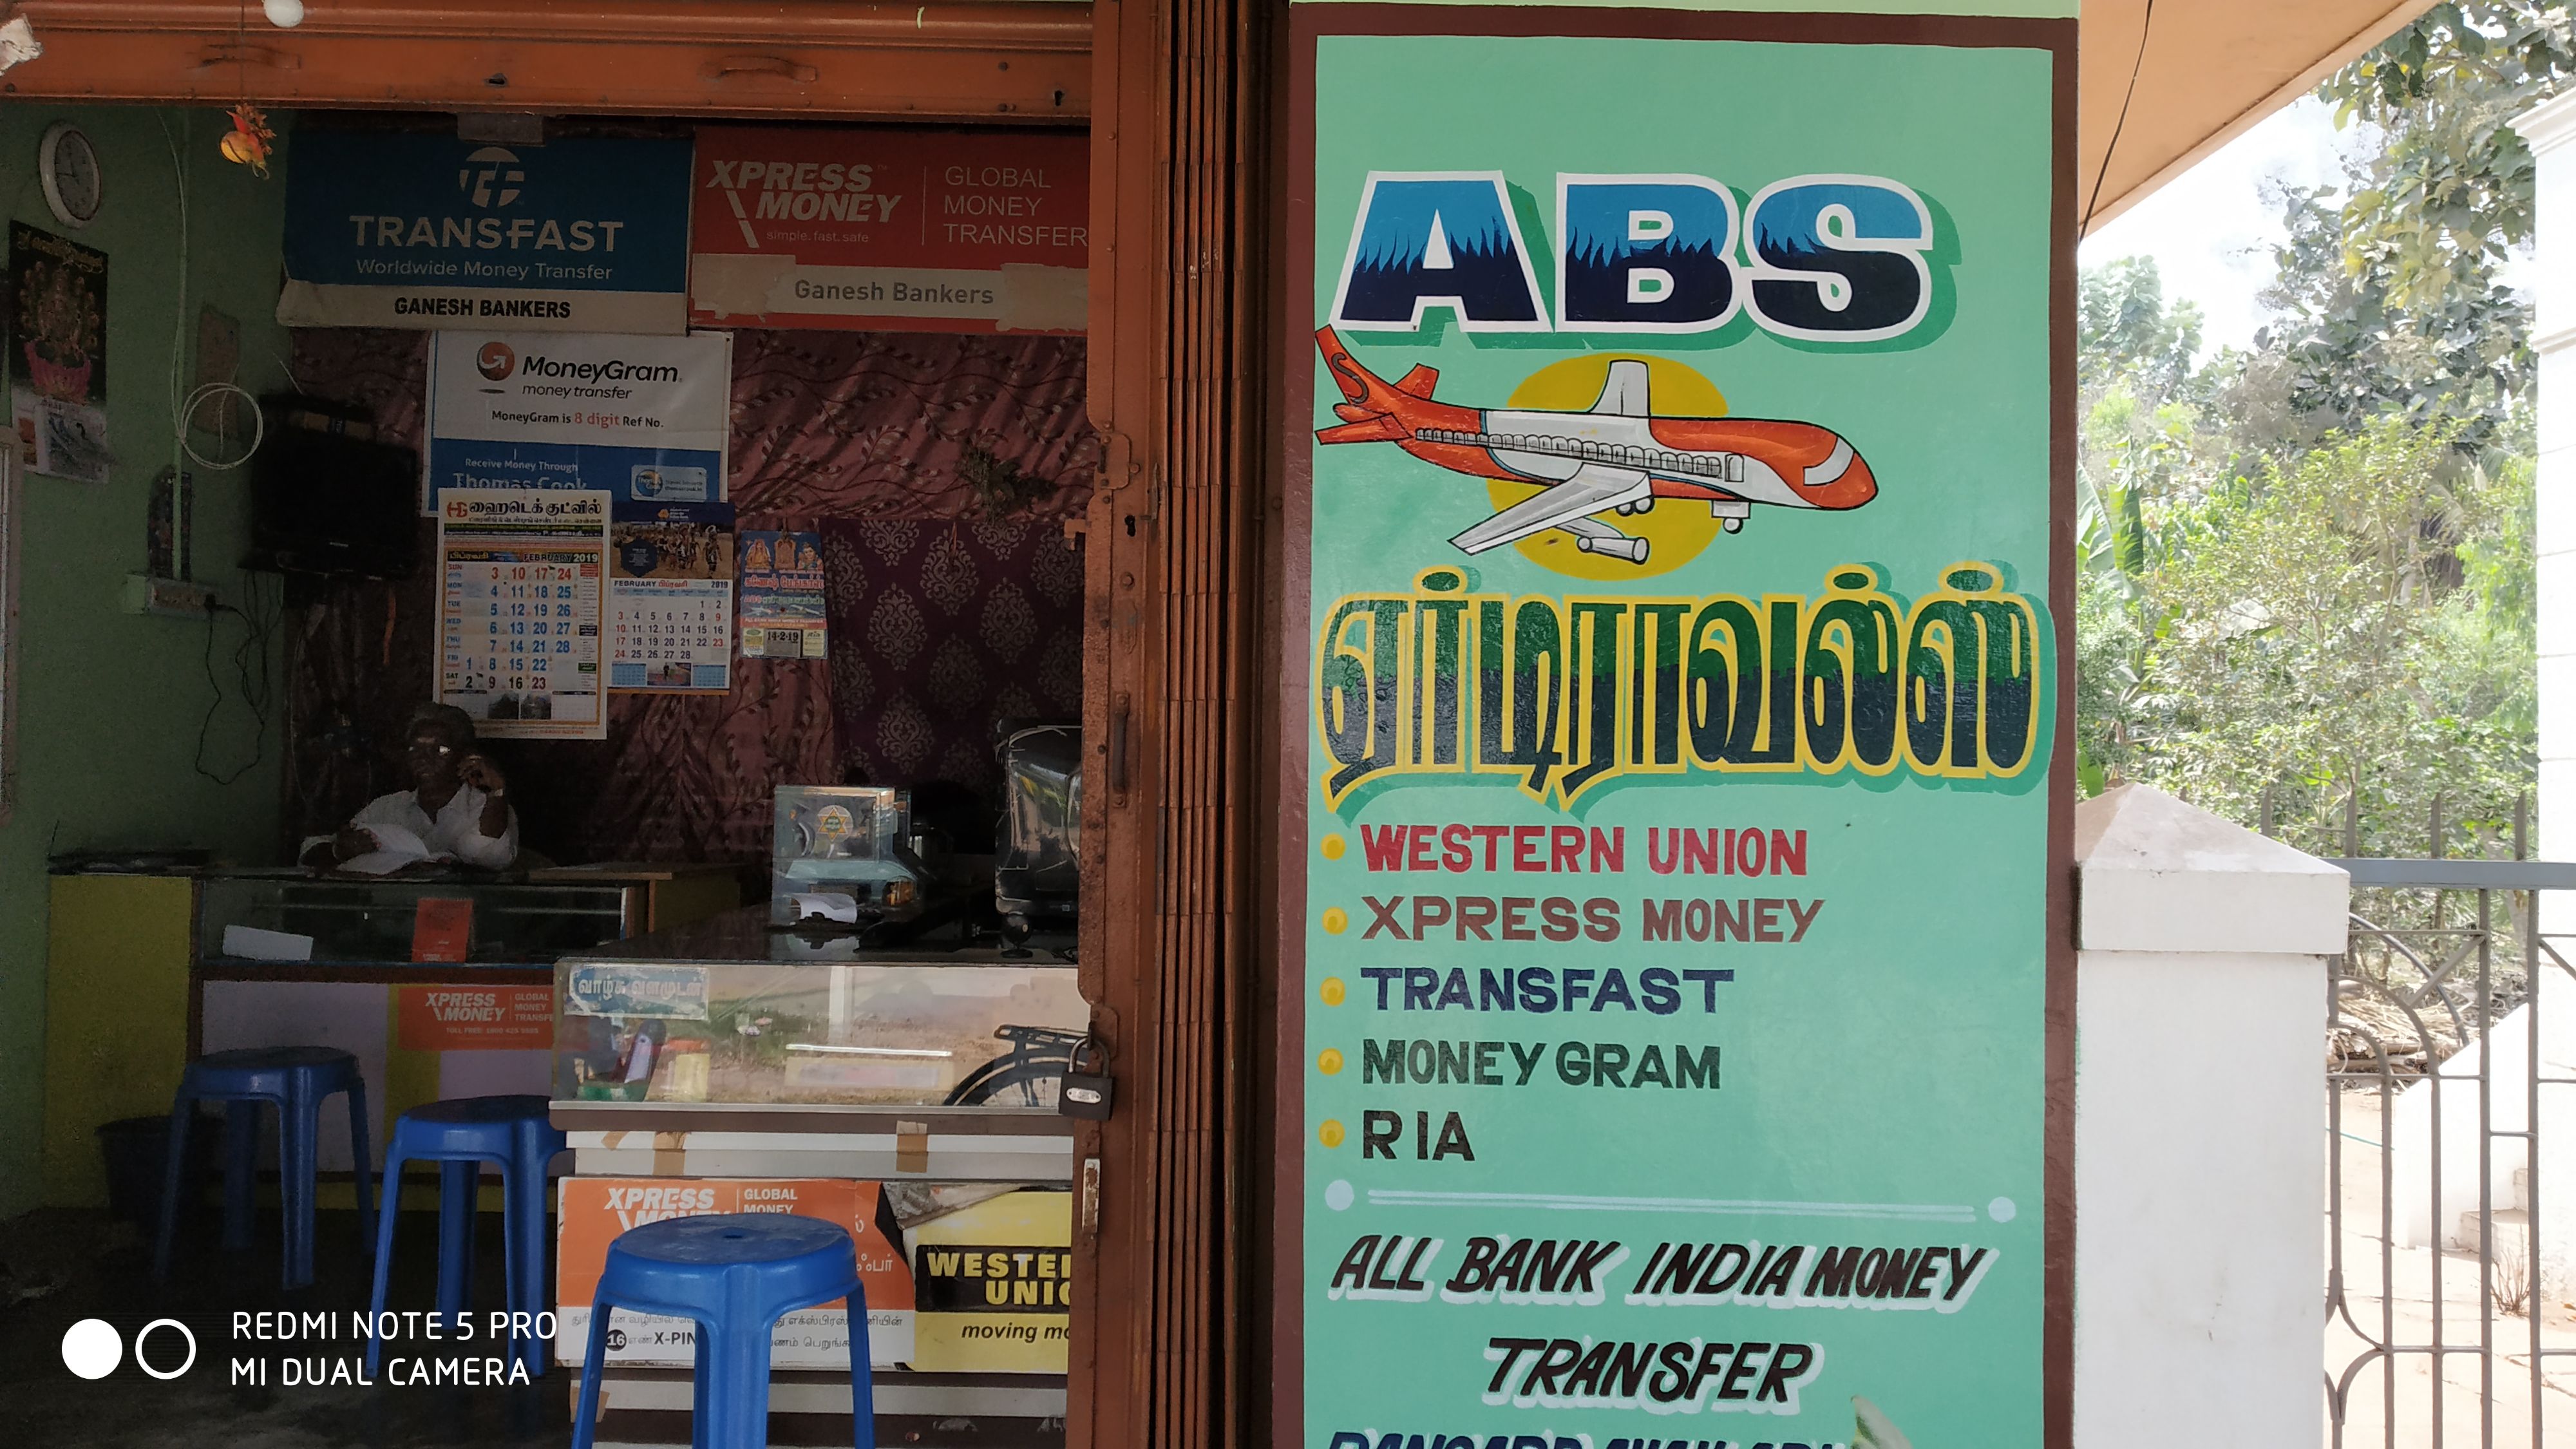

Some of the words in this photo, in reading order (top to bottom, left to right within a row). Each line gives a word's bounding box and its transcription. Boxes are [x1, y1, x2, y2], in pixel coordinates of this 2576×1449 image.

[706, 160, 873, 193] XPRESS
[945, 166, 1051, 189] GLOBAL
[755, 192, 902, 223] MONEY
[943, 195, 1041, 216] MONEY
[349, 214, 624, 252] TRANSFAST
[842, 232, 869, 242] safe
[943, 223, 1088, 247] TRANSFER
[1329, 170, 1934, 343] ABS
[356, 259, 457, 276] Worldwide
[464, 261, 528, 281] Money
[535, 261, 612, 279] Transfer
[795, 279, 884, 301] Ganesh
[893, 282, 994, 304] Bankers
[394, 297, 473, 316] GANESH
[480, 299, 571, 319] BANKERS
[522, 356, 677, 384] MoneyGram
[522, 385, 571, 399] money
[574, 386, 632, 399] transfer
[491, 410, 559, 424] MoneyGram
[562, 413, 571, 423] is
[574, 412, 583, 424] 8
[587, 412, 619, 428] digit
[623, 416, 642, 426] Ref
[645, 418, 664, 428] No.
[466, 458, 502, 468] Receive
[504, 460, 536, 471] Money
[538, 461, 578, 473] Through
[524, 553, 573, 562] FEBRUARY
[573, 554, 598, 562] 2019
[491, 567, 498, 580] 3
[511, 567, 526, 580] 10
[535, 567, 547, 580] 17
[558, 568, 571, 580] 24
[491, 585, 498, 597] 4
[511, 585, 524, 597] 11
[535, 586, 547, 598] 18
[557, 586, 571, 598] 25
[490, 603, 497, 616] 5
[511, 603, 525, 616] 12
[534, 604, 547, 616] 19
[556, 604, 571, 617] 26
[716, 600, 721, 609] 2
[667, 612, 672, 621] 6
[683, 612, 688, 621] 7
[489, 622, 497, 634] 6
[510, 622, 524, 634] 13
[533, 622, 547, 634] 20
[556, 622, 571, 634] 27
[649, 625, 658, 633] 12
[490, 639, 497, 652] 7
[510, 640, 524, 652] 14
[533, 641, 545, 652] 21
[556, 641, 570, 653] 28
[664, 638, 674, 647] 20
[681, 638, 690, 647] 21
[696, 638, 707, 647] 22
[713, 638, 723, 647] 23
[631, 650, 641, 658] 25
[664, 650, 674, 659] 27
[680, 650, 690, 659] 28
[467, 658, 471, 670] 1
[489, 658, 496, 670] 8
[509, 658, 524, 670] 15
[532, 659, 547, 670] 22
[466, 676, 473, 688] 2
[489, 677, 495, 688] 9
[509, 677, 522, 689] 16
[532, 677, 546, 689] 23
[1360, 824, 1625, 873] WESTERN
[1648, 828, 1807, 876] UNION
[1360, 896, 1621, 943] XPRESS
[1643, 899, 1826, 943] MONEY
[1360, 967, 1734, 1015] TRANSFAST
[425, 992, 496, 1007] XPRESS
[444, 1008, 506, 1021] MONEY
[1362, 1110, 1475, 1161] RIA
[603, 1188, 714, 1210] XPRESS
[744, 1189, 797, 1200] GLOBAL
[744, 1204, 793, 1214] MONEY
[1331, 1235, 1432, 1290] ALL
[1448, 1238, 1620, 1294] BANK
[1633, 1242, 1804, 1296] INDIA
[1805, 1245, 1987, 1302] MONEY
[607, 1334, 626, 1346] 16
[961, 1324, 1037, 1343] moving
[1486, 1337, 1814, 1403] TRANSFER
